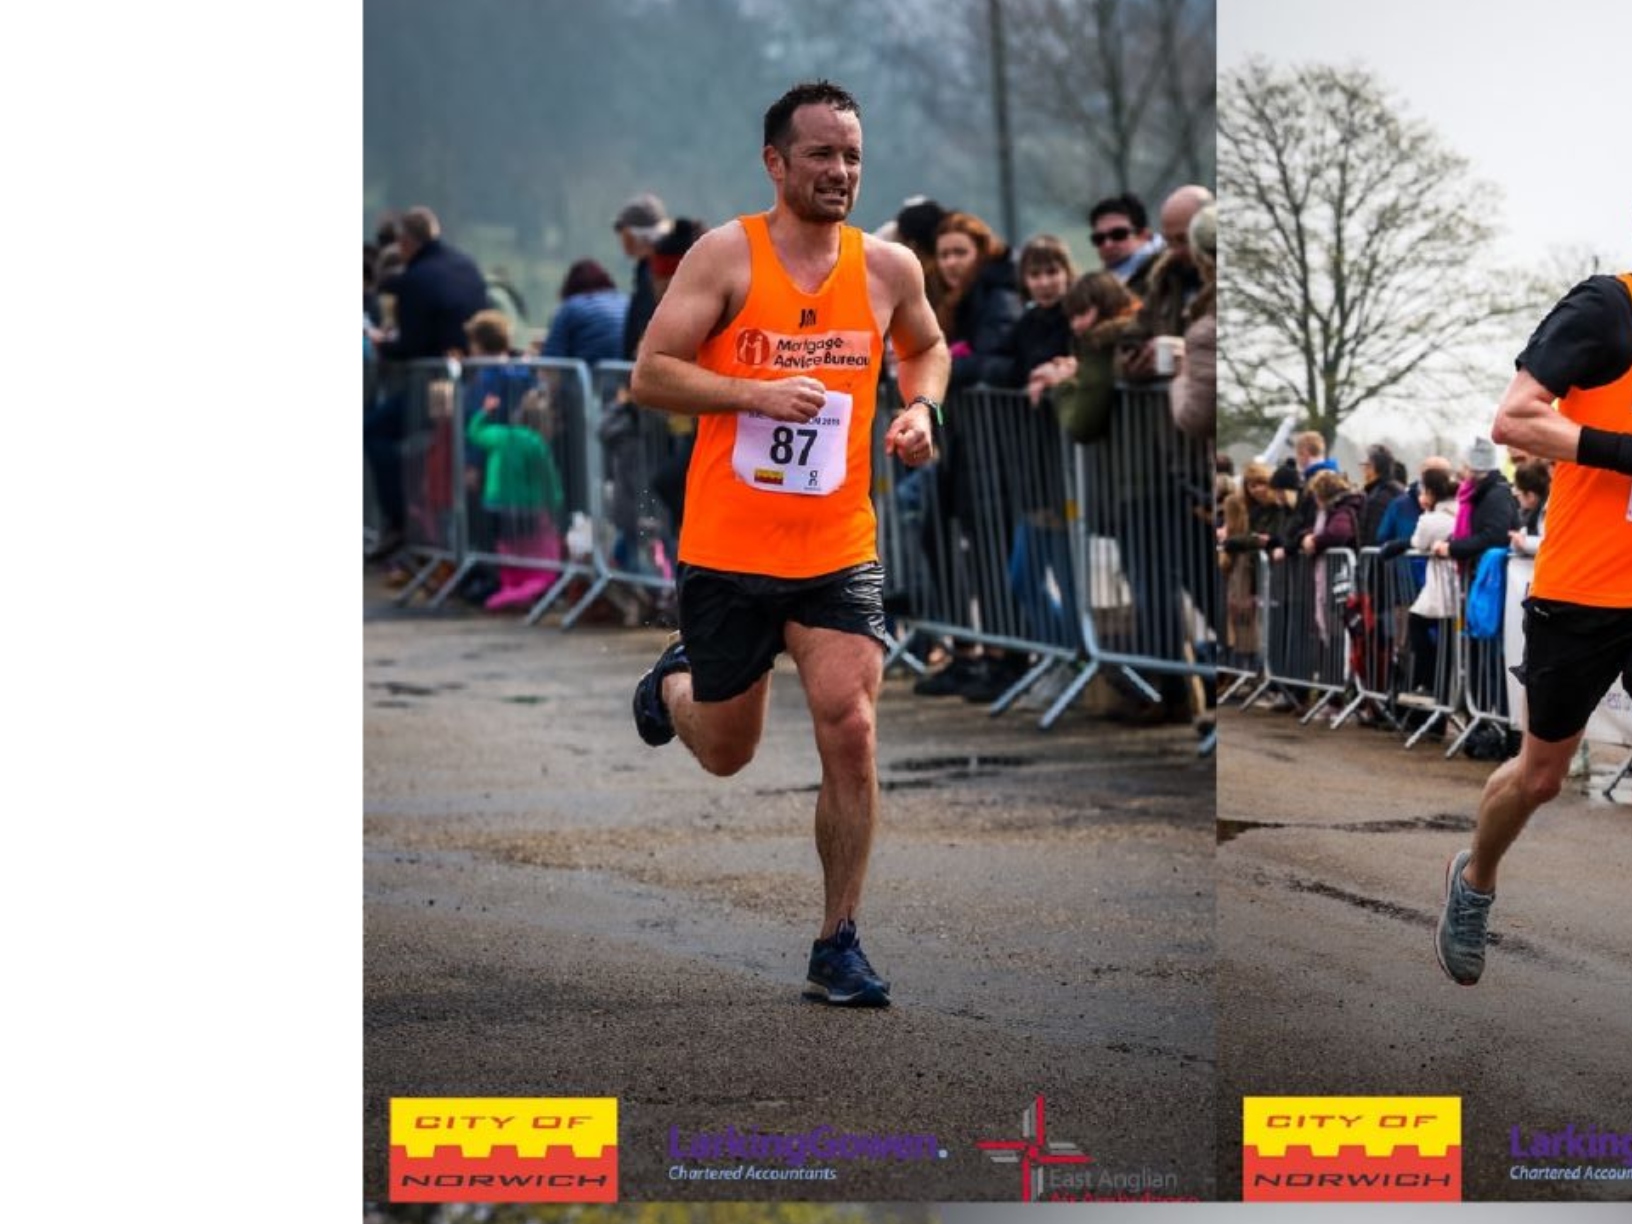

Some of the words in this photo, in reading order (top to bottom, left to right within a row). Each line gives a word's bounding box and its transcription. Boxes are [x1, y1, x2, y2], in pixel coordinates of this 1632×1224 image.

[776, 338, 844, 355] Mortgage
[774, 354, 823, 369] Advice
[823, 351, 871, 367] Bureau
[769, 425, 818, 466] 87
